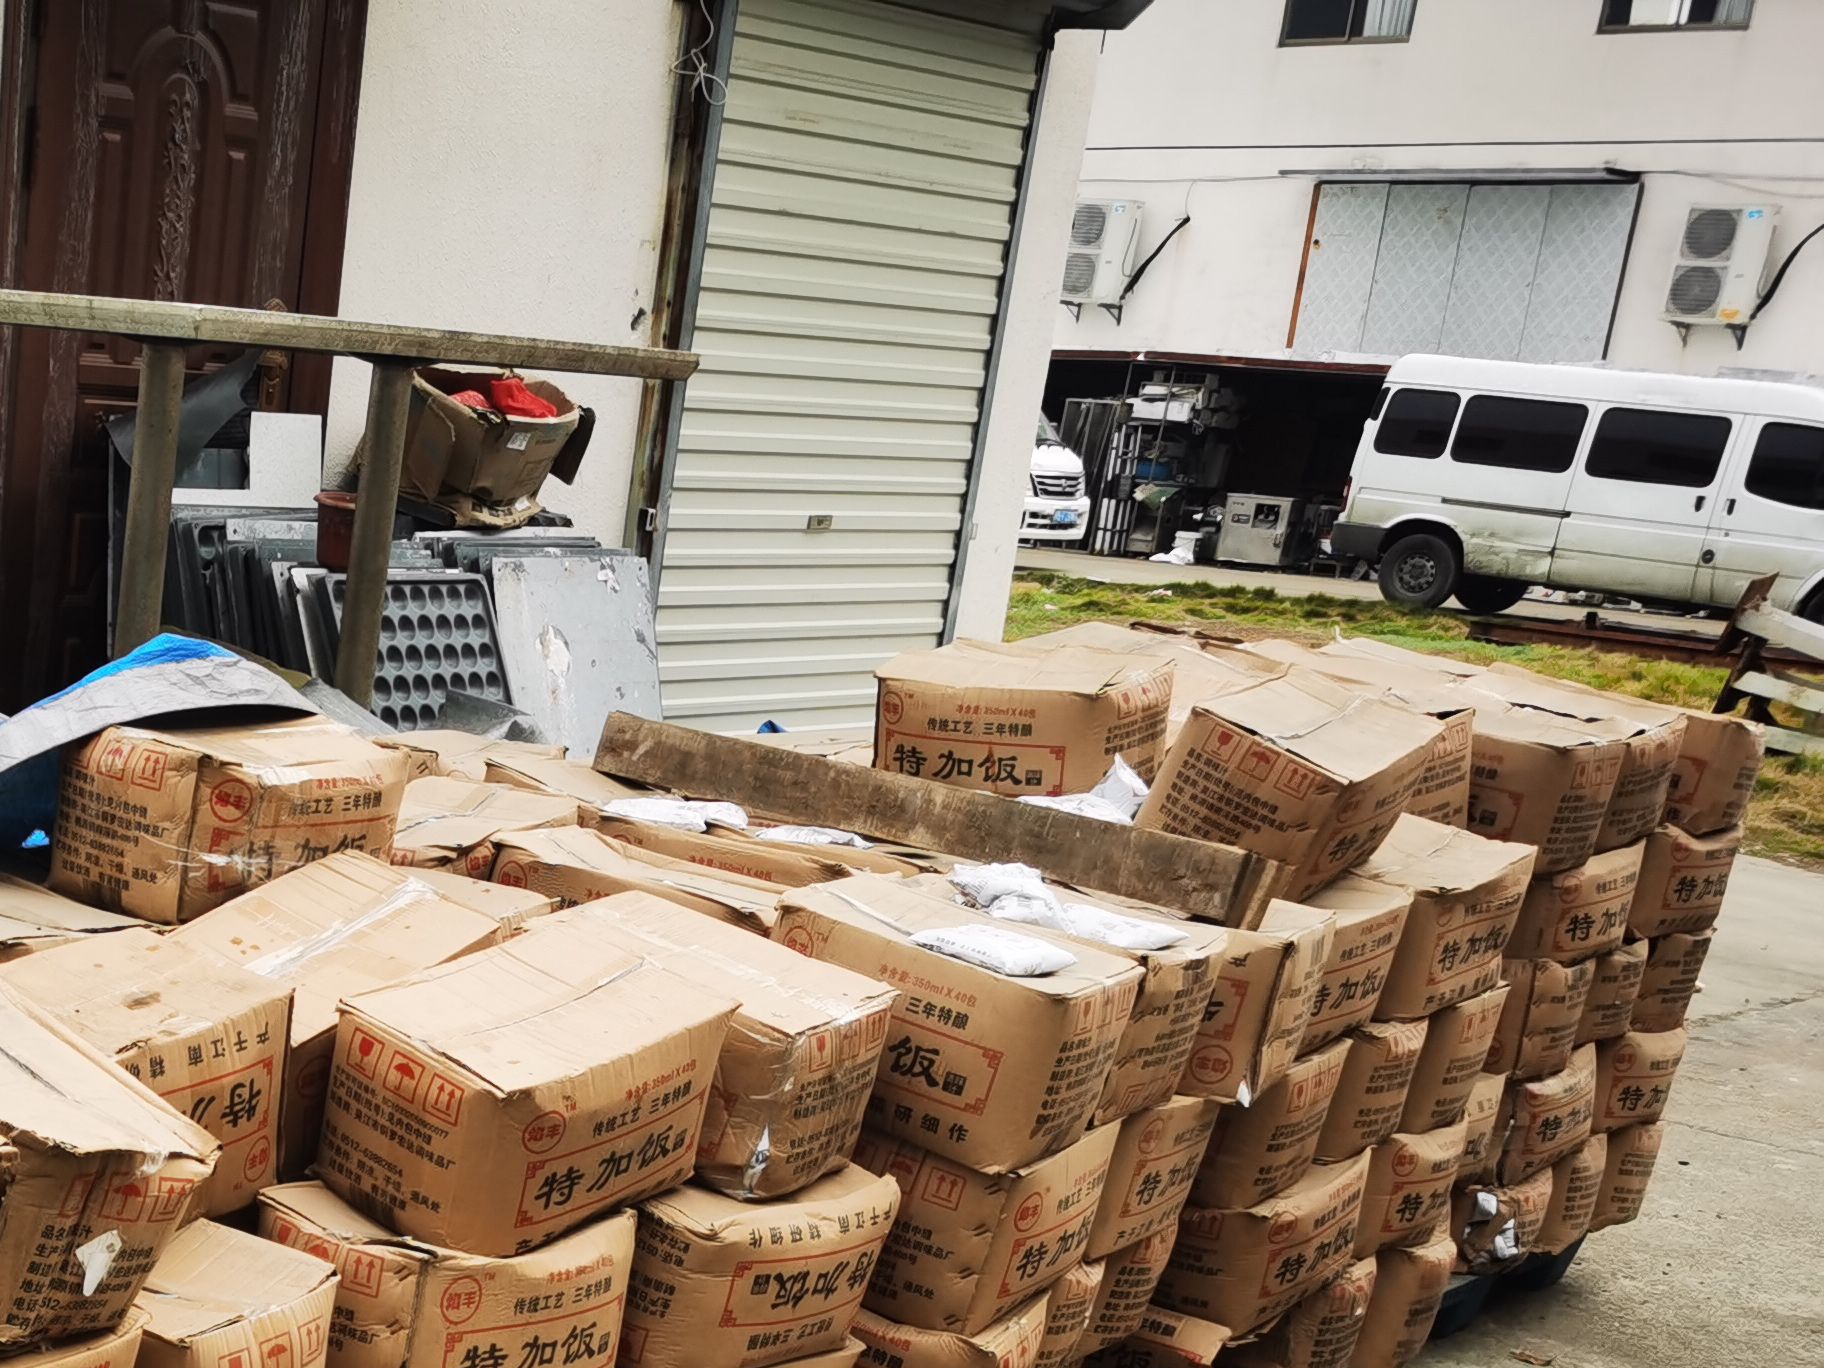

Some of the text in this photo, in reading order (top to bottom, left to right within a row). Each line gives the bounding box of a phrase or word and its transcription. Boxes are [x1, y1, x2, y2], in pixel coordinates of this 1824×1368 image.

[926, 718, 1033, 737] 传统工艺 三年特酿
[892, 744, 1023, 786] 特加饭
[905, 997, 969, 1031] 三年特酿
[887, 1036, 940, 1089] 饭
[592, 1080, 693, 1138] 传统工艺 三年特酿
[535, 1125, 674, 1210] 特加饭
[514, 1276, 612, 1316] 传统工艺 三年特酿
[771, 1251, 874, 1311] 特加饭
